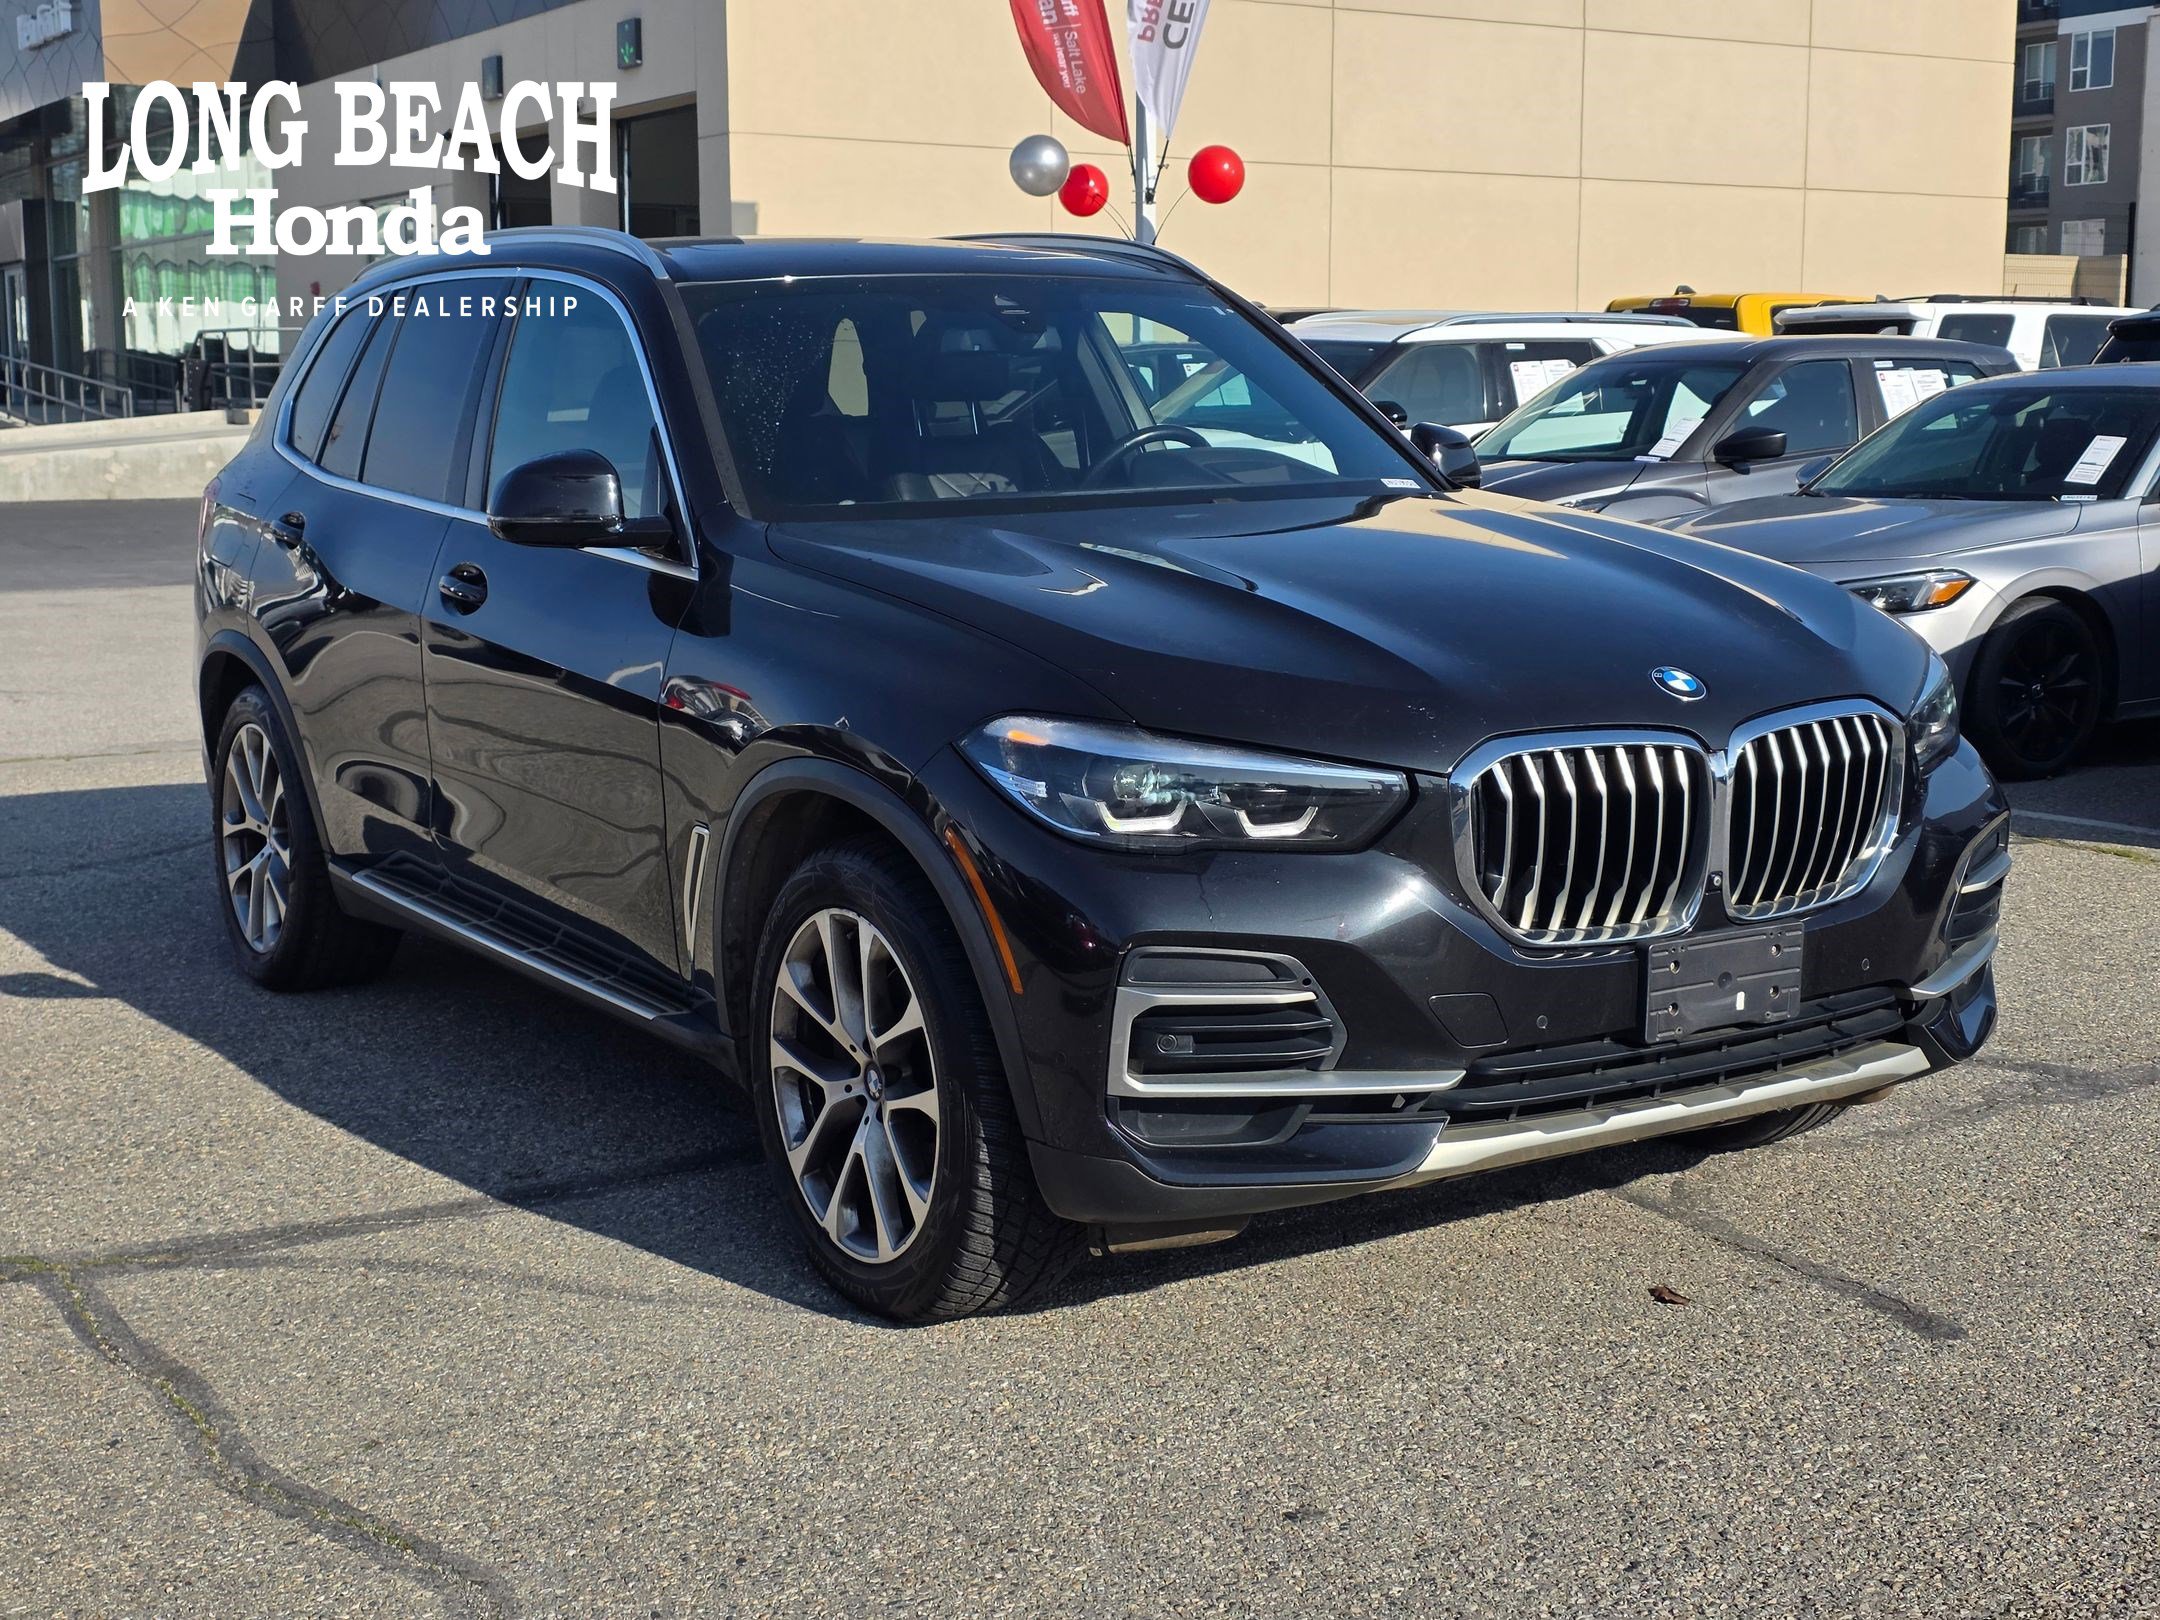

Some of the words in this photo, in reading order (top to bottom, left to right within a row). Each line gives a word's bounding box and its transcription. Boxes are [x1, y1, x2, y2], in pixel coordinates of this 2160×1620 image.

[1064, 31, 1081, 57] Salt
[1059, 68, 1071, 88] you
[1071, 60, 1087, 94] Lake
